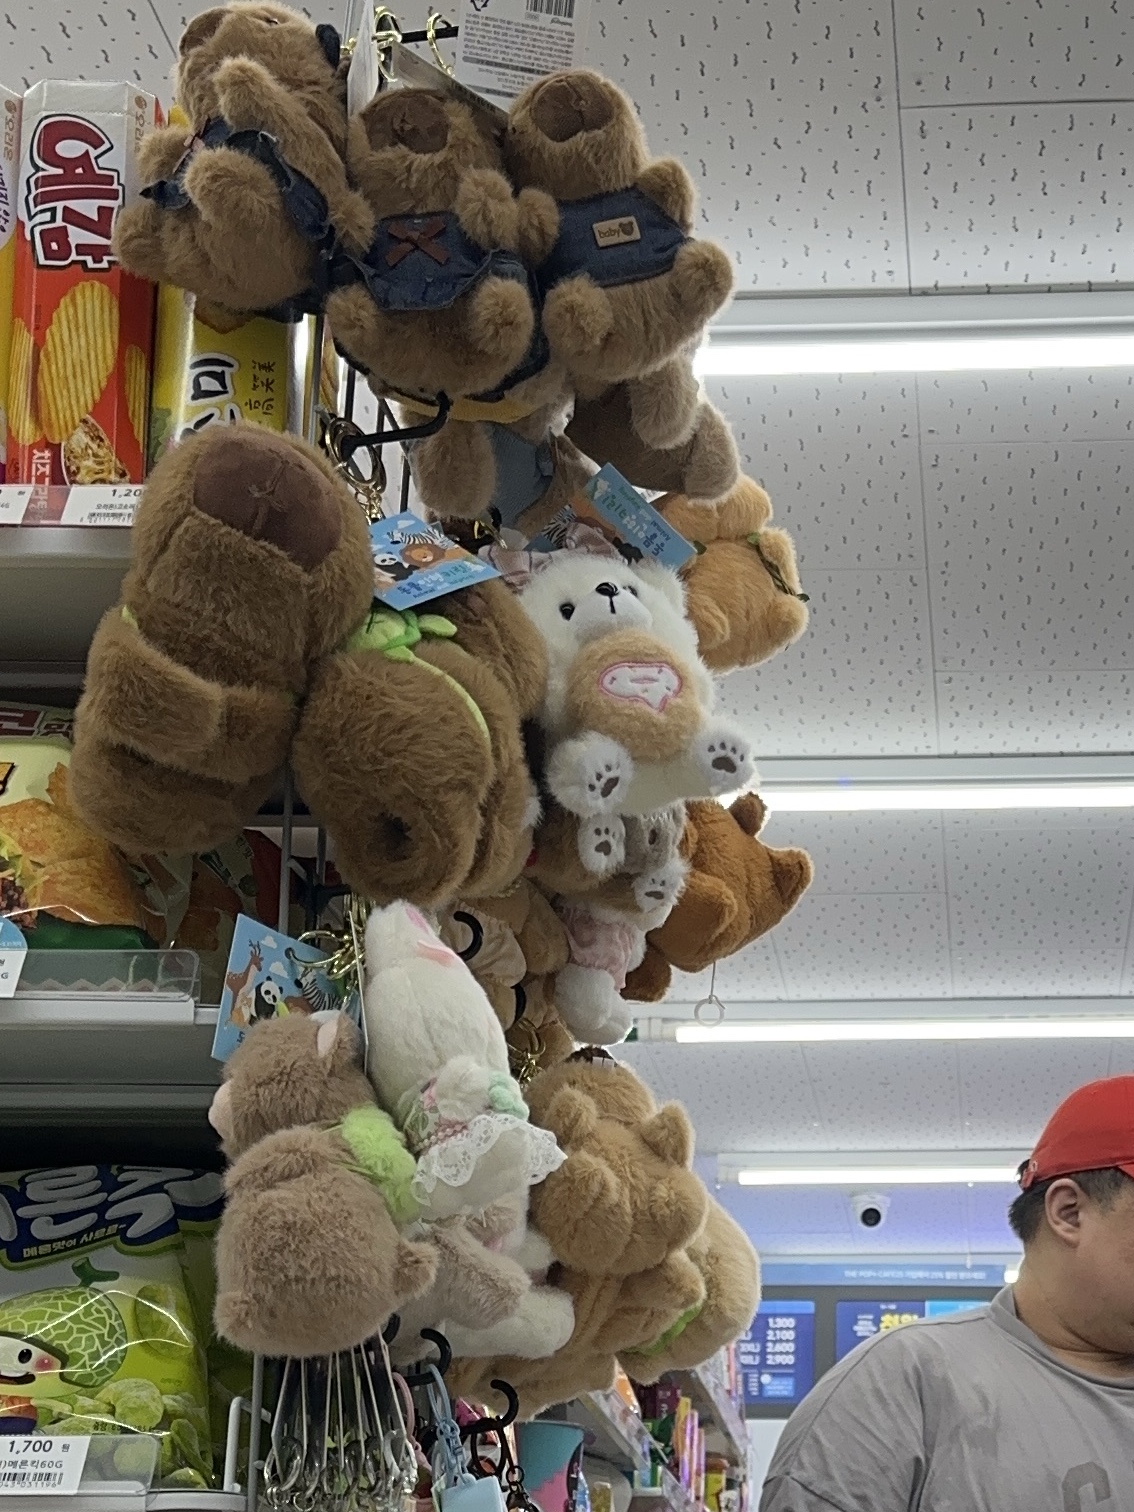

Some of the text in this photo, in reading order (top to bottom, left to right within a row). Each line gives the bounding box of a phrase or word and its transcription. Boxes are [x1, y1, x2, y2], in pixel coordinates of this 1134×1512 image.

[30, 115, 121, 267] 예감
[597, 225, 622, 241] baby
[111, 488, 142, 498] 1,20
[8, 1440, 54, 1455] 1,700
